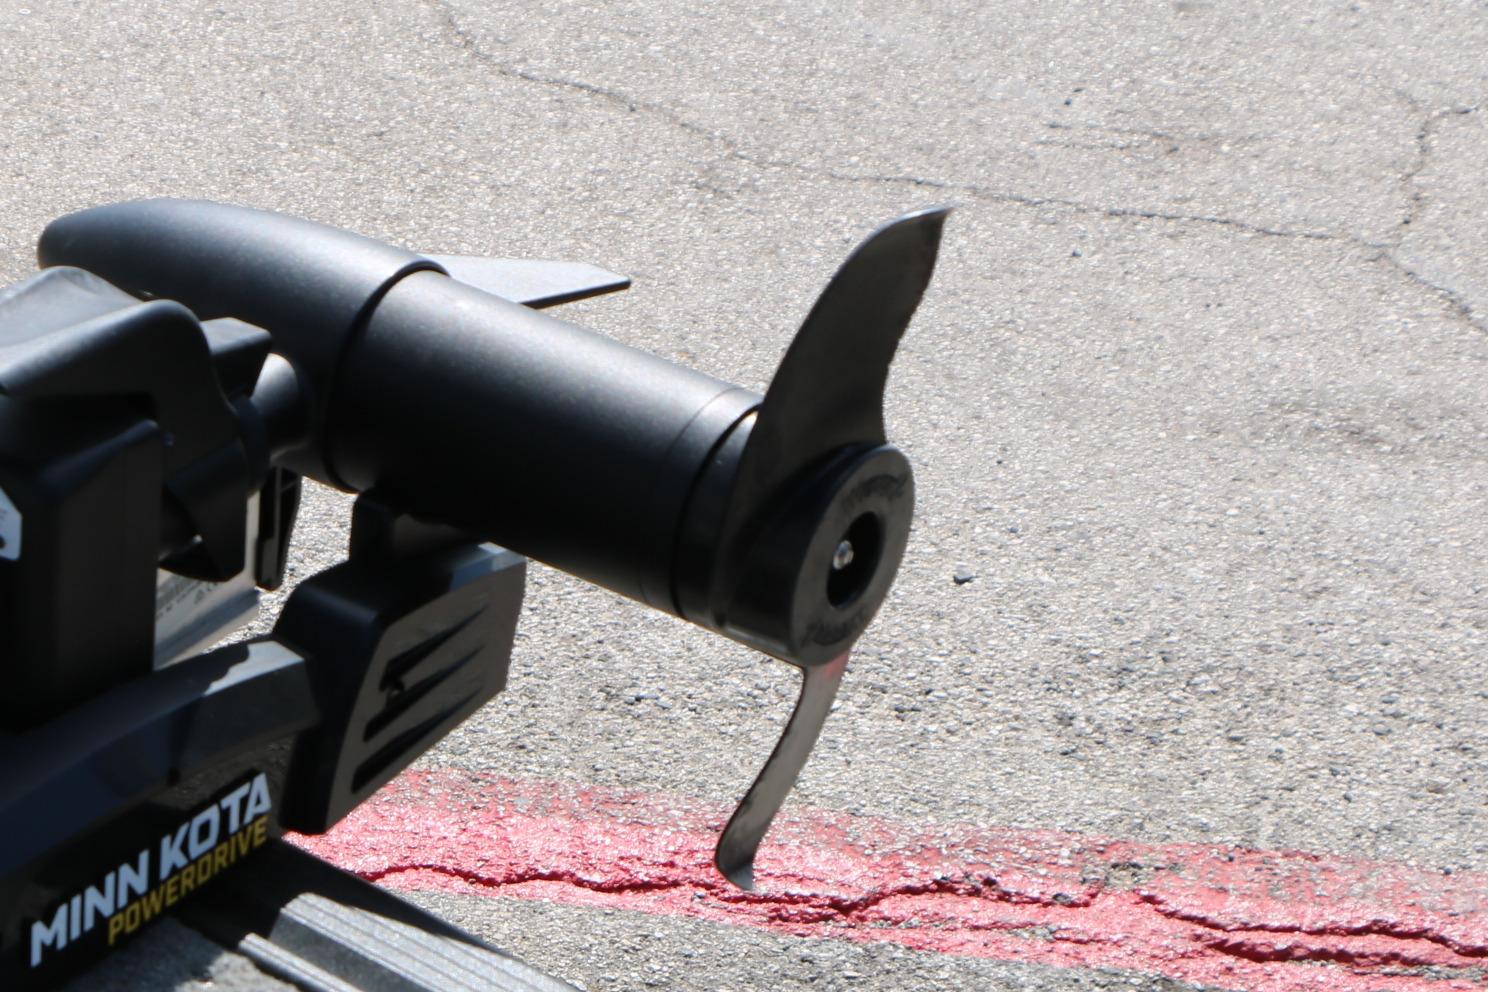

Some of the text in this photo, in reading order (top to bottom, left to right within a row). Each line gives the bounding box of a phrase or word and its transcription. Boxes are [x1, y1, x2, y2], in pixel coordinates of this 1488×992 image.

[30, 772, 272, 967] MINN KOTA
[107, 816, 269, 946] POWERDRIVE
